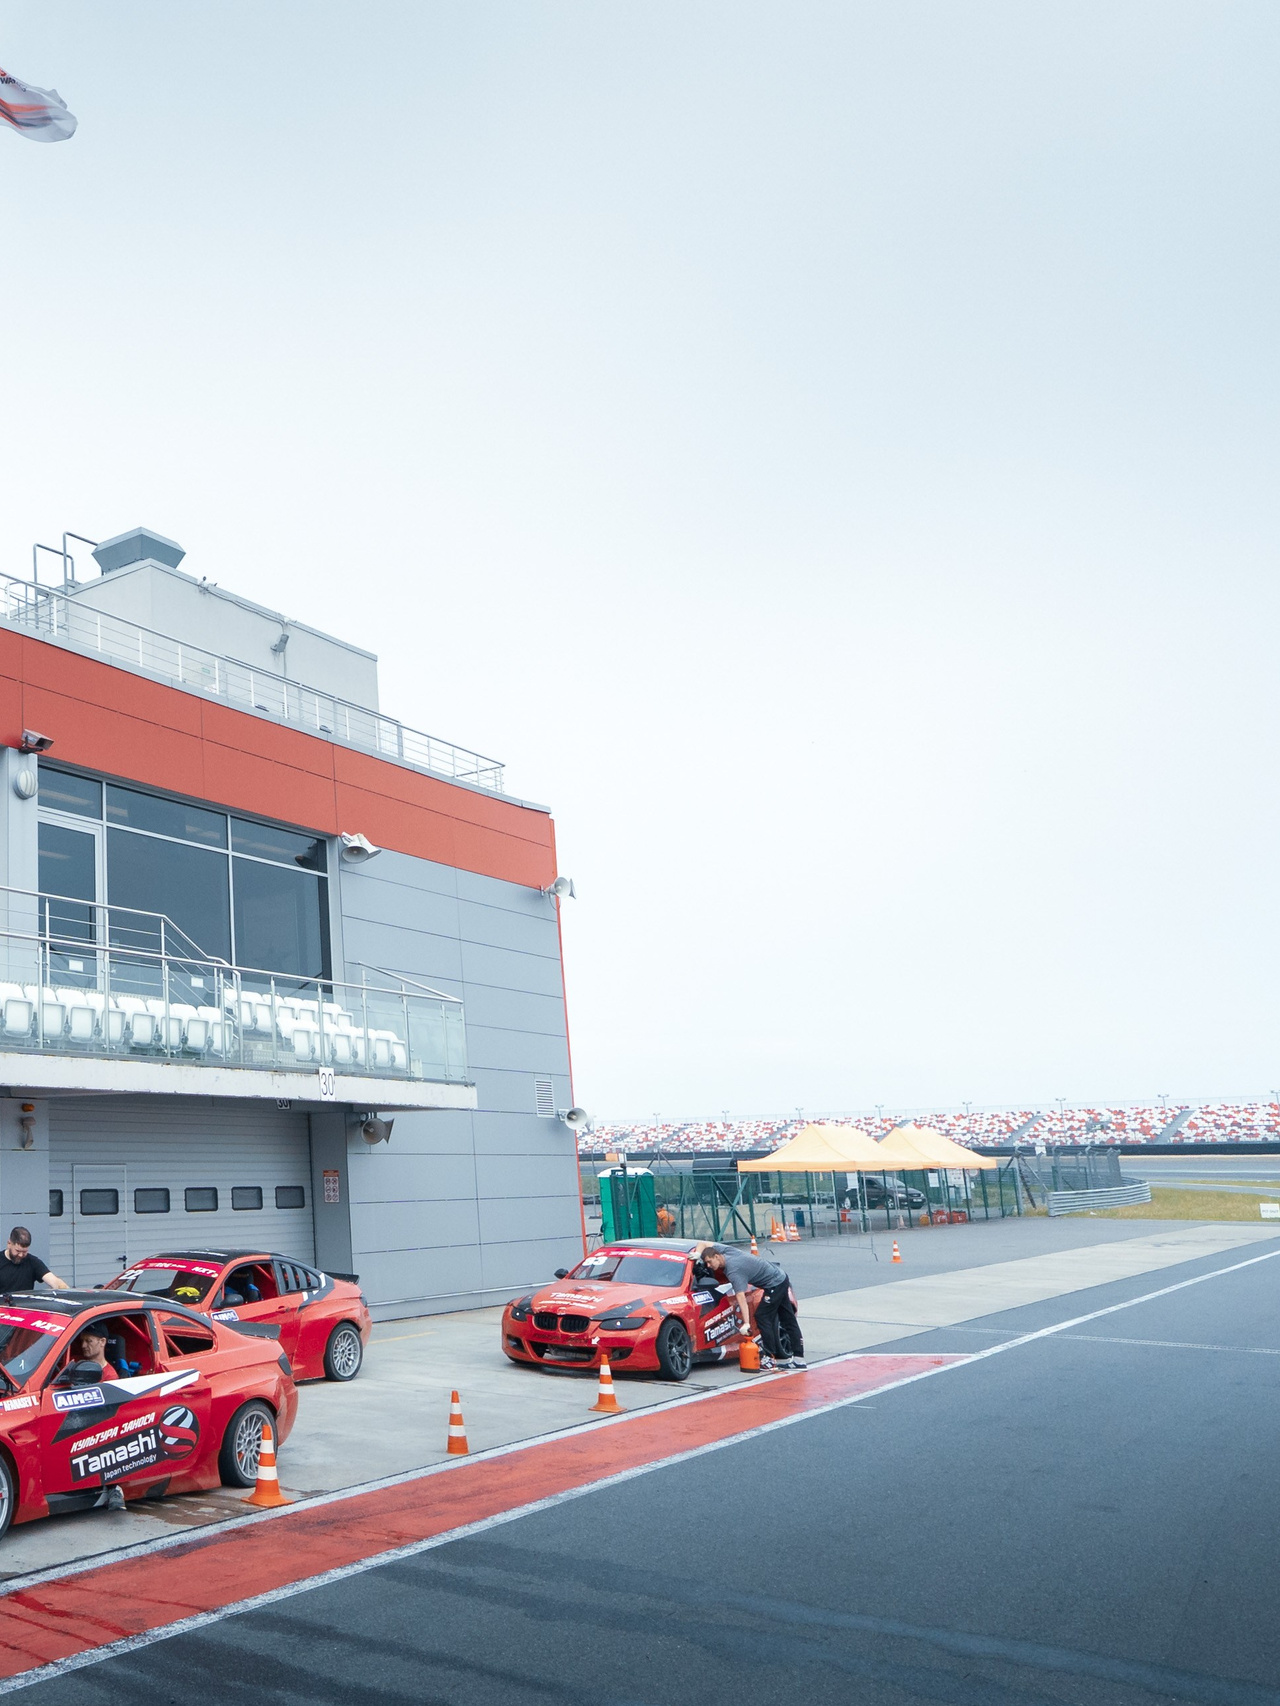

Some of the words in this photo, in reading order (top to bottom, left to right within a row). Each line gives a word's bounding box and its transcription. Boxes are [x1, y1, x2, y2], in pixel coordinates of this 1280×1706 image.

[321, 1073, 334, 1095] 30
[118, 1269, 144, 1280] 22
[30, 1320, 66, 1332] NXT
[57, 1390, 102, 1408] AIMOL
[70, 1426, 119, 1454] КУЛЬТУРА
[120, 1412, 156, 1435] ЗАНОСА
[72, 1429, 157, 1477] Tamashi
[104, 1467, 122, 1480] Japan
[122, 1453, 157, 1471] technology
